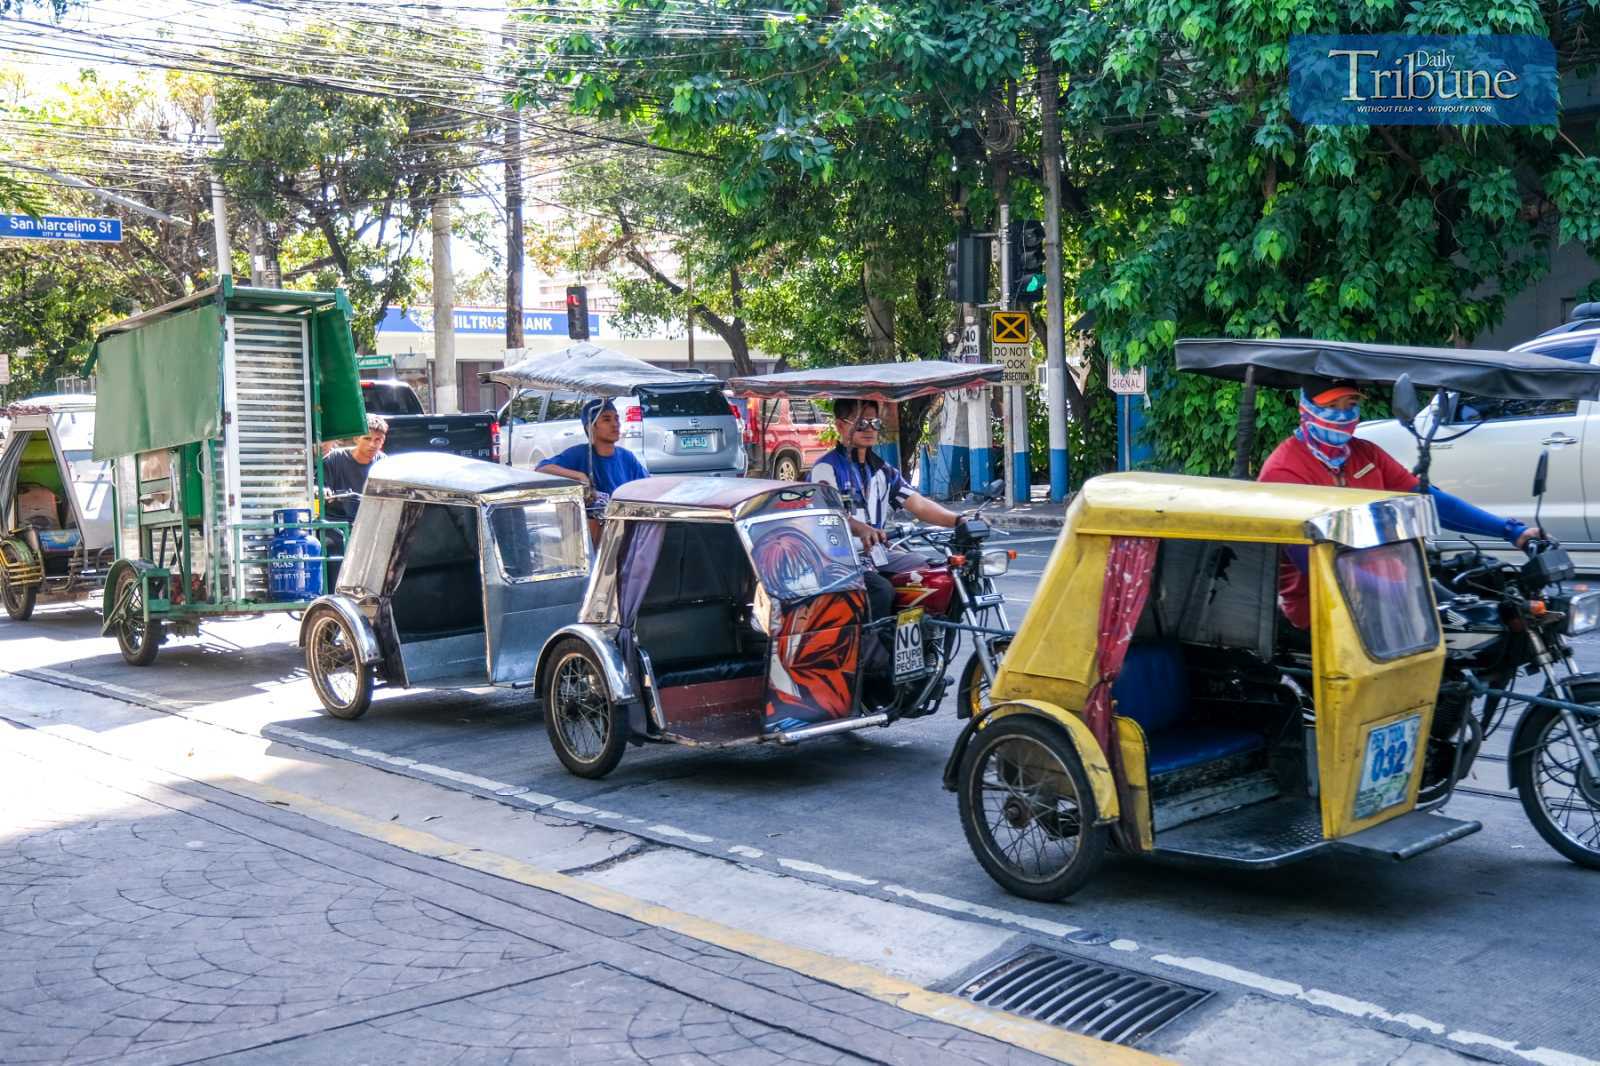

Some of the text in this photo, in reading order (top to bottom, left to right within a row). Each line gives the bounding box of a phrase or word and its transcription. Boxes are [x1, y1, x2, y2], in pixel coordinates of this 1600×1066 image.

[10, 217, 112, 234] San Marcelino St
[523, 317, 553, 331] ANK
[993, 347, 1027, 356] DO NOT
[1112, 378, 1140, 389] SIGNAL
[896, 623, 921, 651] NO
[896, 647, 922, 662] STUPID
[896, 657, 924, 672] PEOPLE
[1372, 740, 1407, 782] 032
